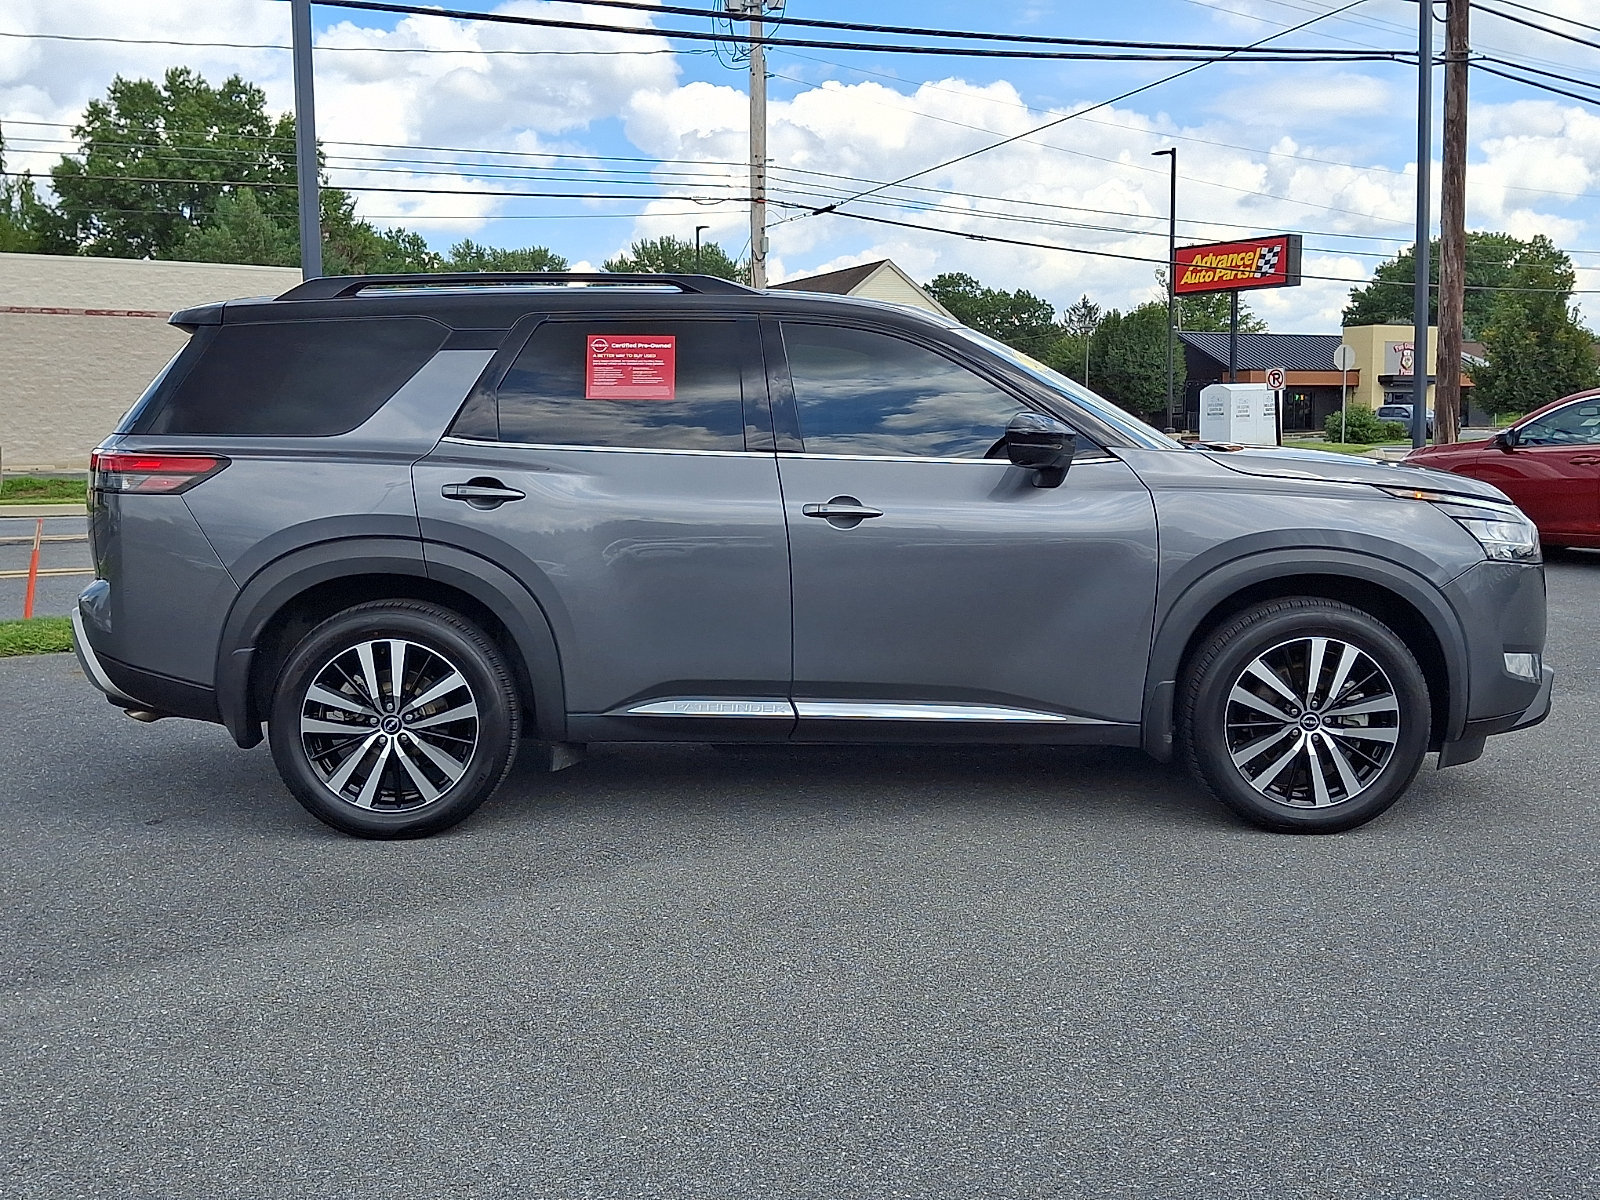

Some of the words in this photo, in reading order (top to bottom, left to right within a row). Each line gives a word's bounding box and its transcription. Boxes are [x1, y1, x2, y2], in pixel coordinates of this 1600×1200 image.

[1188, 251, 1254, 270] Advance
[1180, 270, 1212, 284] Auto
[673, 702, 786, 713] PATHFINDER
